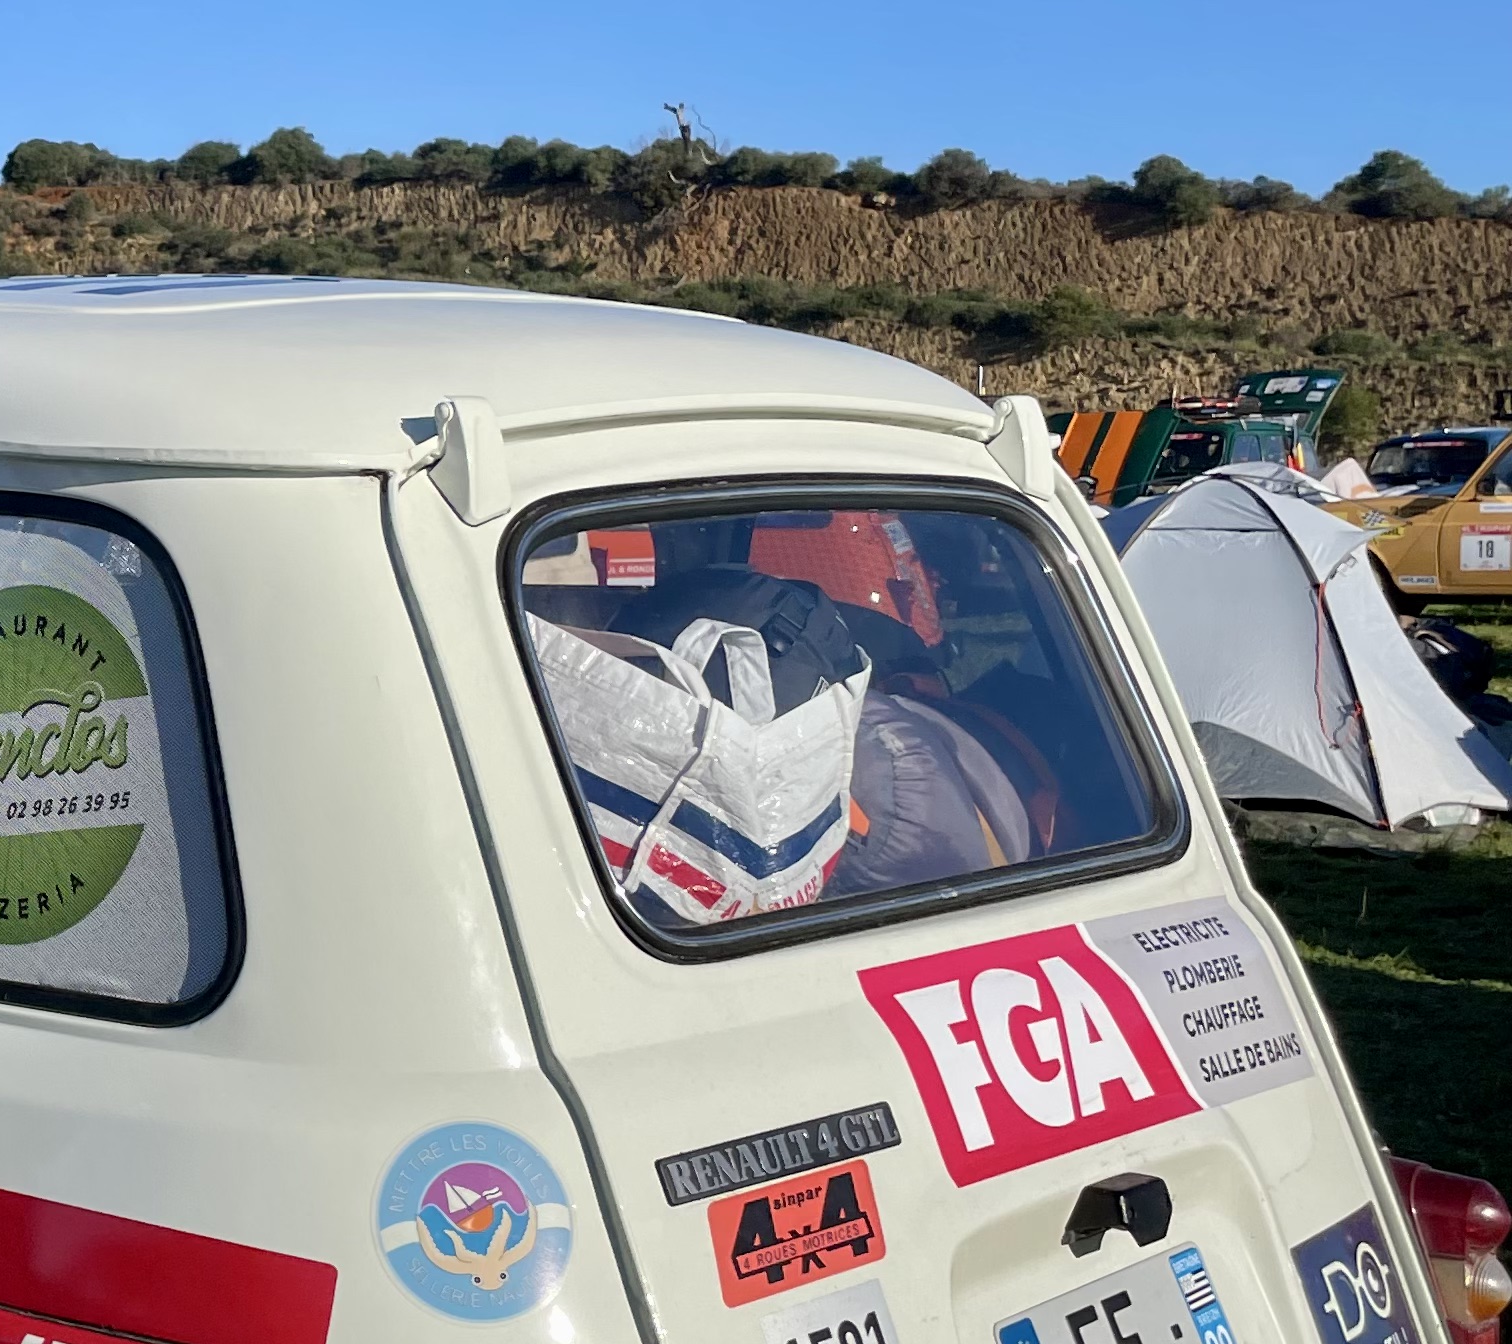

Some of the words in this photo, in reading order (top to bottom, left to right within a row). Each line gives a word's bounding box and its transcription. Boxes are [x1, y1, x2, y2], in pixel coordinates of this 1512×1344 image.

[6, 801, 27, 820] 02
[31, 798, 53, 818] 98
[57, 796, 78, 815] 26
[82, 793, 104, 813] 39
[109, 791, 131, 811] 95
[1132, 916, 1230, 953] ELECTRICITE
[1162, 954, 1245, 994] PLOMBERIE
[1182, 995, 1265, 1038] CHAUFFAGE
[893, 955, 1156, 1153] FGA
[1199, 1047, 1246, 1083] SALLE
[1243, 1043, 1266, 1069] DE
[1264, 1032, 1302, 1064] BAINS
[389, 1141, 445, 1213] METTRE
[449, 1133, 487, 1153] LES
[496, 1140, 548, 1200] VOILES
[666, 1127, 815, 1199] RENAULT
[817, 1122, 840, 1158] 4
[839, 1108, 899, 1153] GTL
[772, 1185, 823, 1212] sinpar
[743, 1256, 751, 1270] 4
[756, 1243, 797, 1266] ROUES
[802, 1223, 861, 1251] MOTRICES
[406, 1257, 482, 1309] SELLERIE
